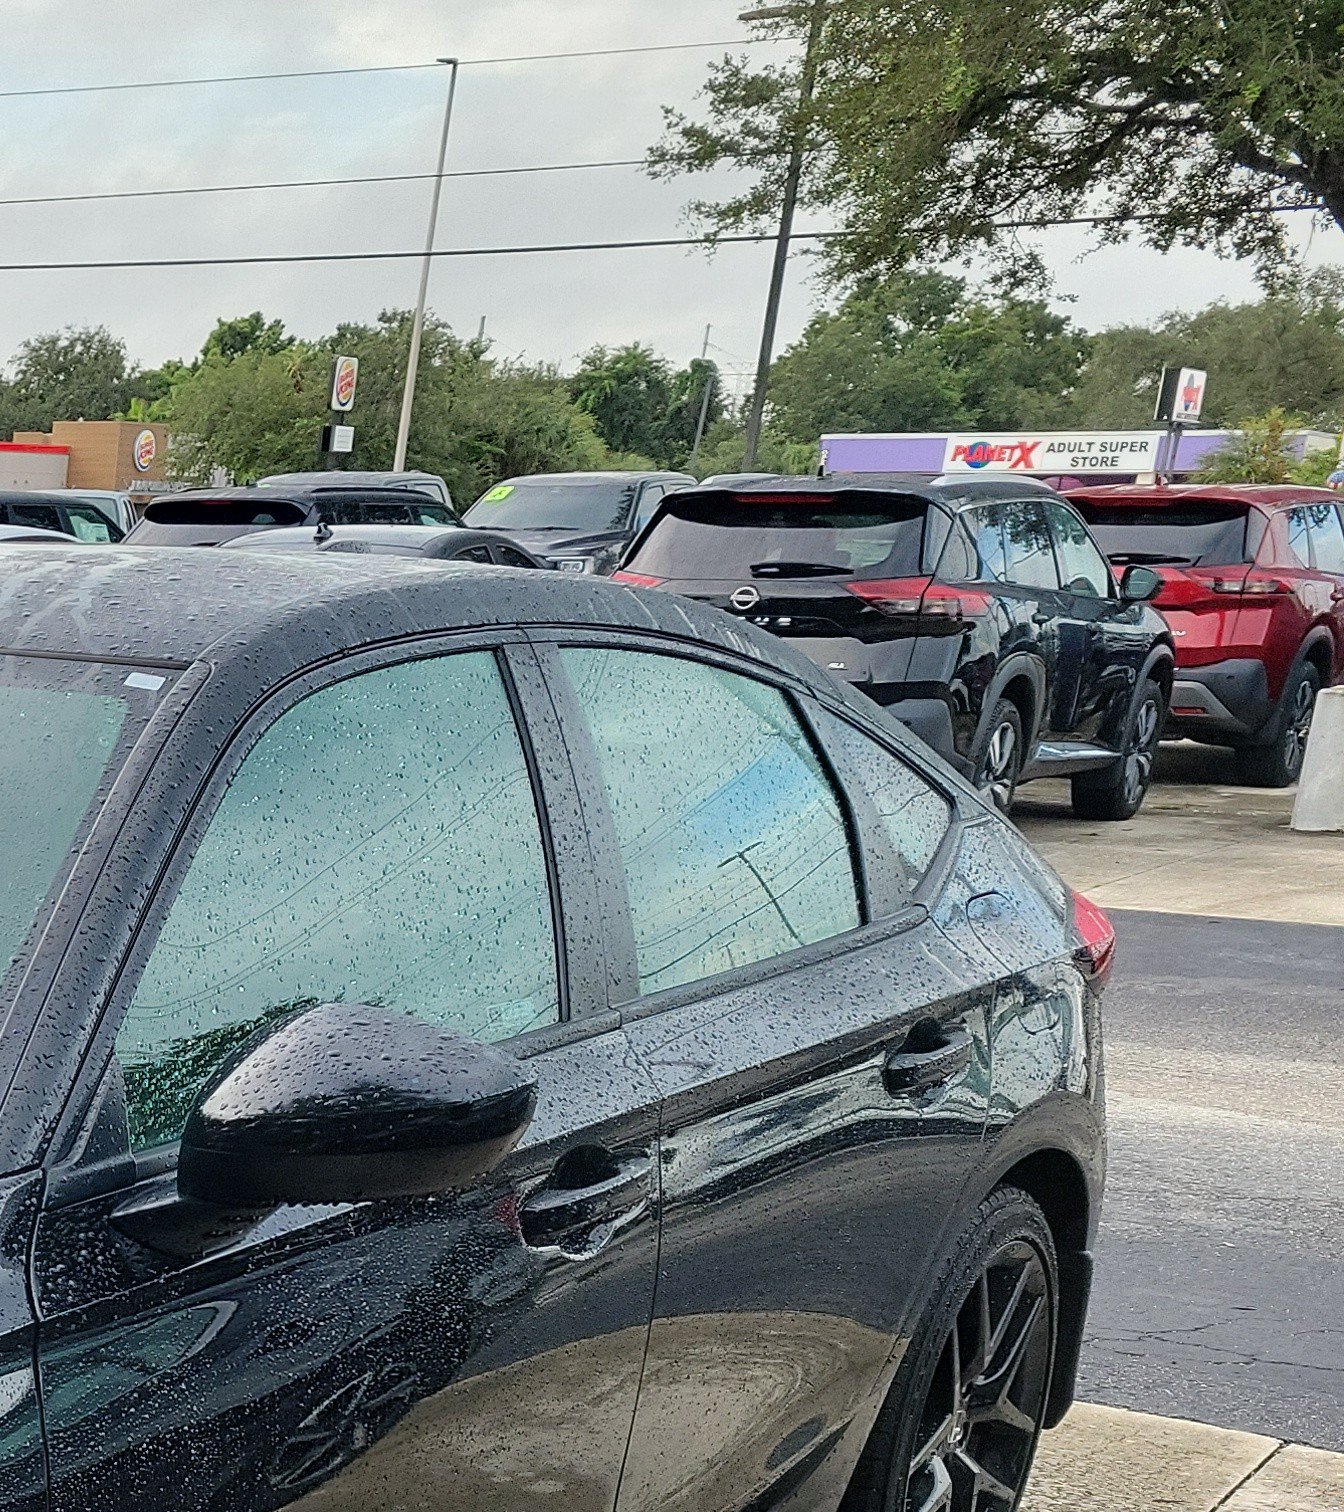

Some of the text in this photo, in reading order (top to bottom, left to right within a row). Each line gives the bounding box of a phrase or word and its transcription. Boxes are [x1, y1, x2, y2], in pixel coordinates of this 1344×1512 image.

[1045, 441, 1149, 453] ADULT SUPER
[1070, 456, 1120, 468] STORE
